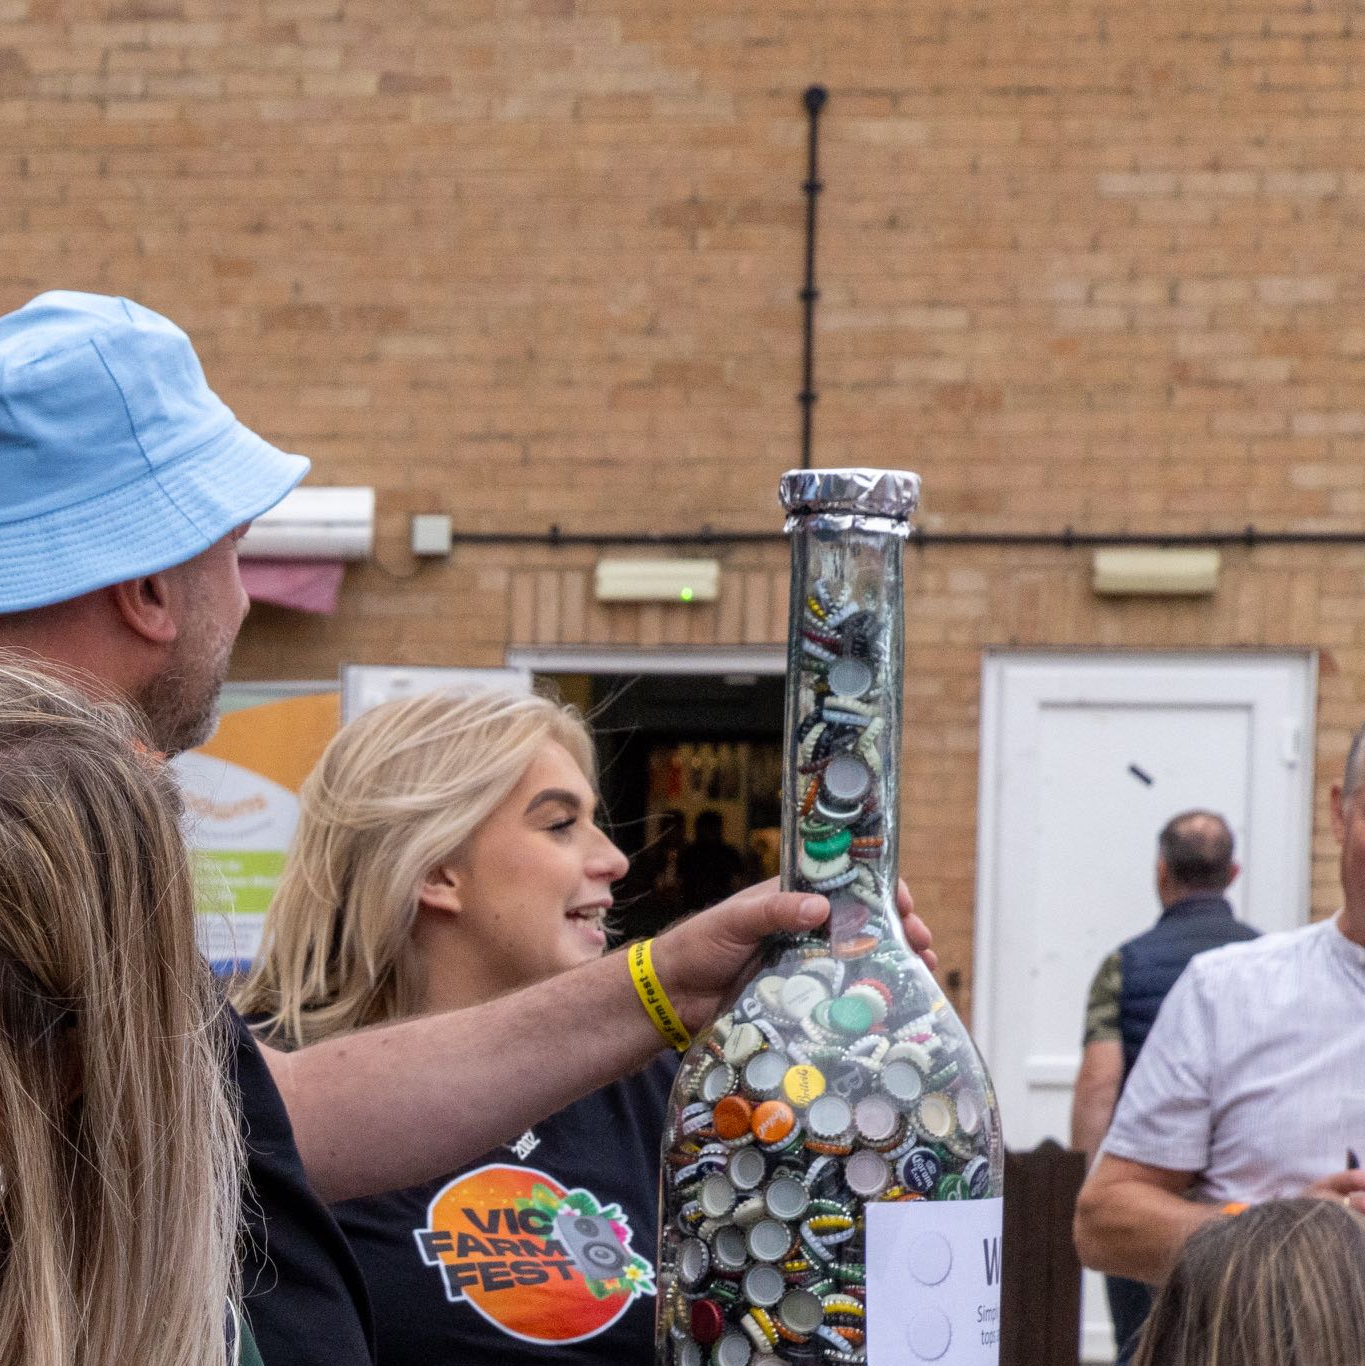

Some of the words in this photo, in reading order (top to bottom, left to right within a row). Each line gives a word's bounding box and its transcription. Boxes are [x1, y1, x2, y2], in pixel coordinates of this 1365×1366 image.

[910, 1166, 924, 1188] Extra
[911, 1153, 934, 1190] Corona
[460, 1207, 554, 1236] VIC
[419, 1230, 570, 1262] FARM
[445, 1260, 575, 1298] FEST
